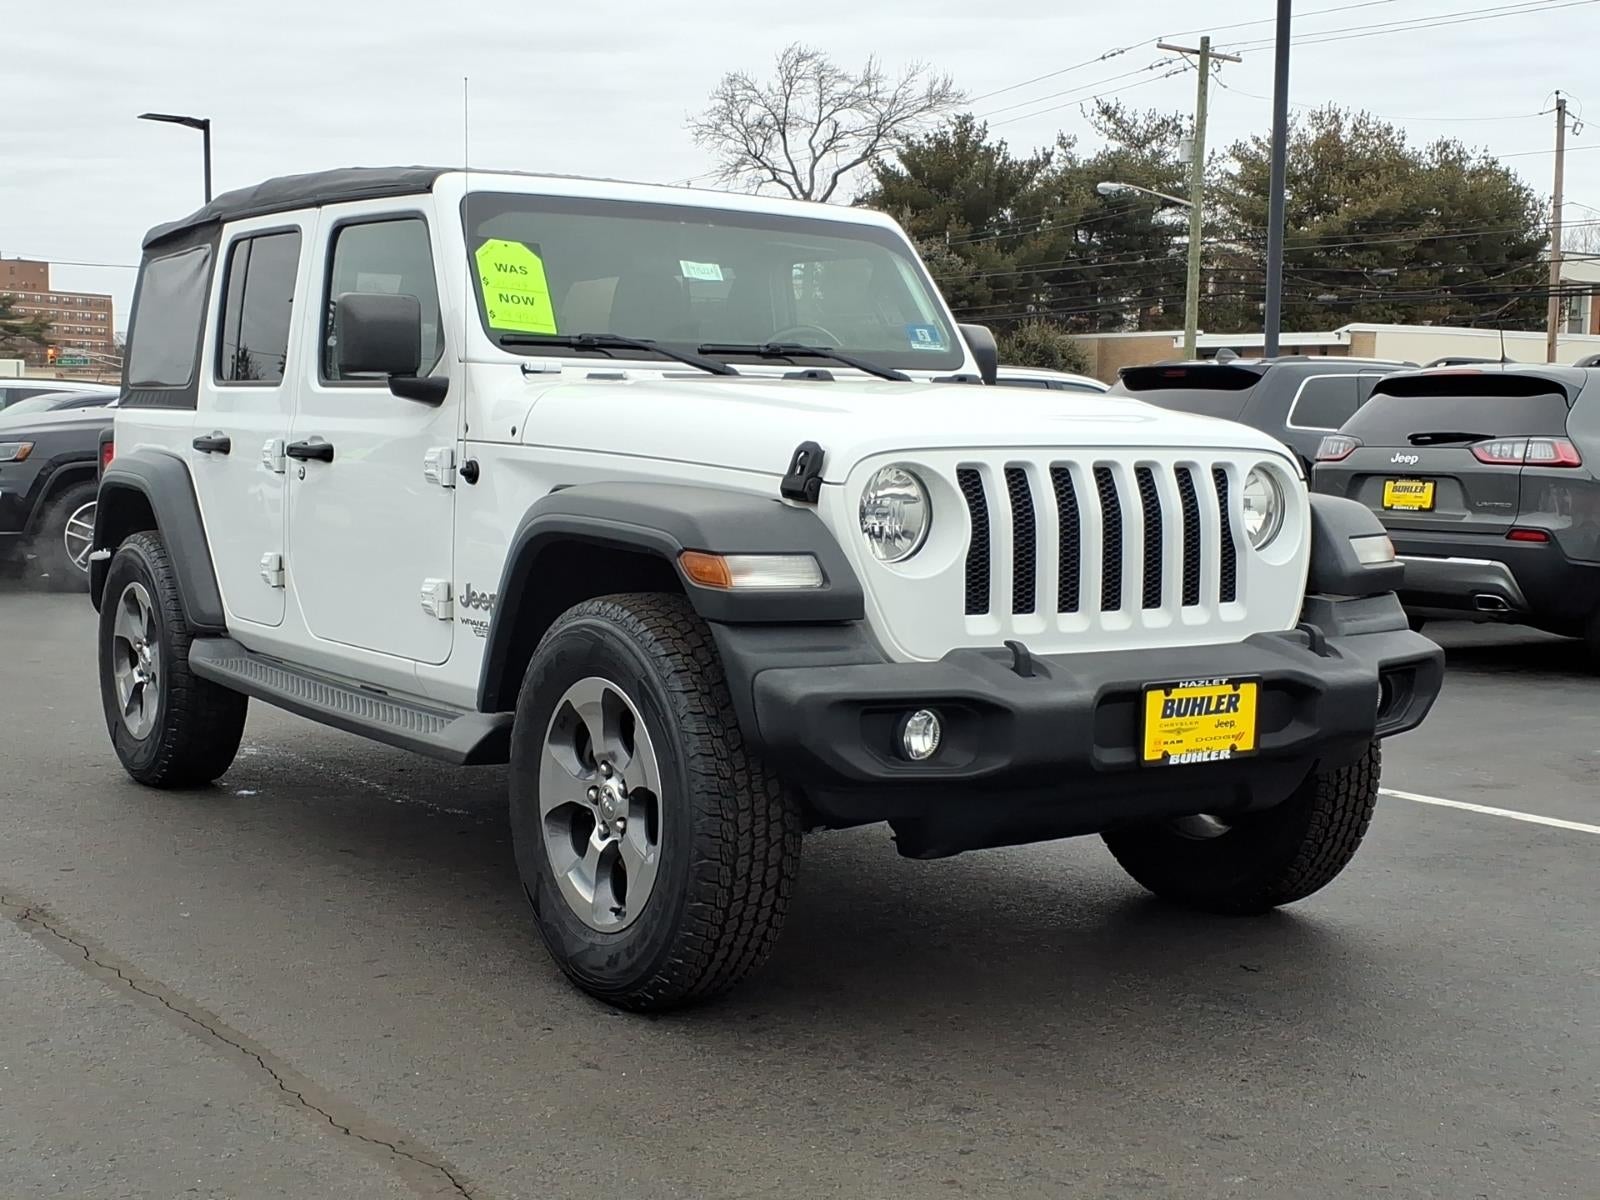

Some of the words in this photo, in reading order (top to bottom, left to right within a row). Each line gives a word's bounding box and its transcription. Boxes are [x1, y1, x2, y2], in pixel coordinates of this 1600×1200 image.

[494, 262, 528, 275] WAS
[499, 293, 534, 306] NOW
[1391, 452, 1419, 465] Jeep
[1392, 485, 1425, 493] BUHLER
[1179, 678, 1229, 688] HAZLET
[1160, 693, 1240, 719] BUHLER
[1214, 719, 1235, 729] Jeep
[1195, 734, 1236, 743] DODGE
[1169, 750, 1230, 765] BUHLER
